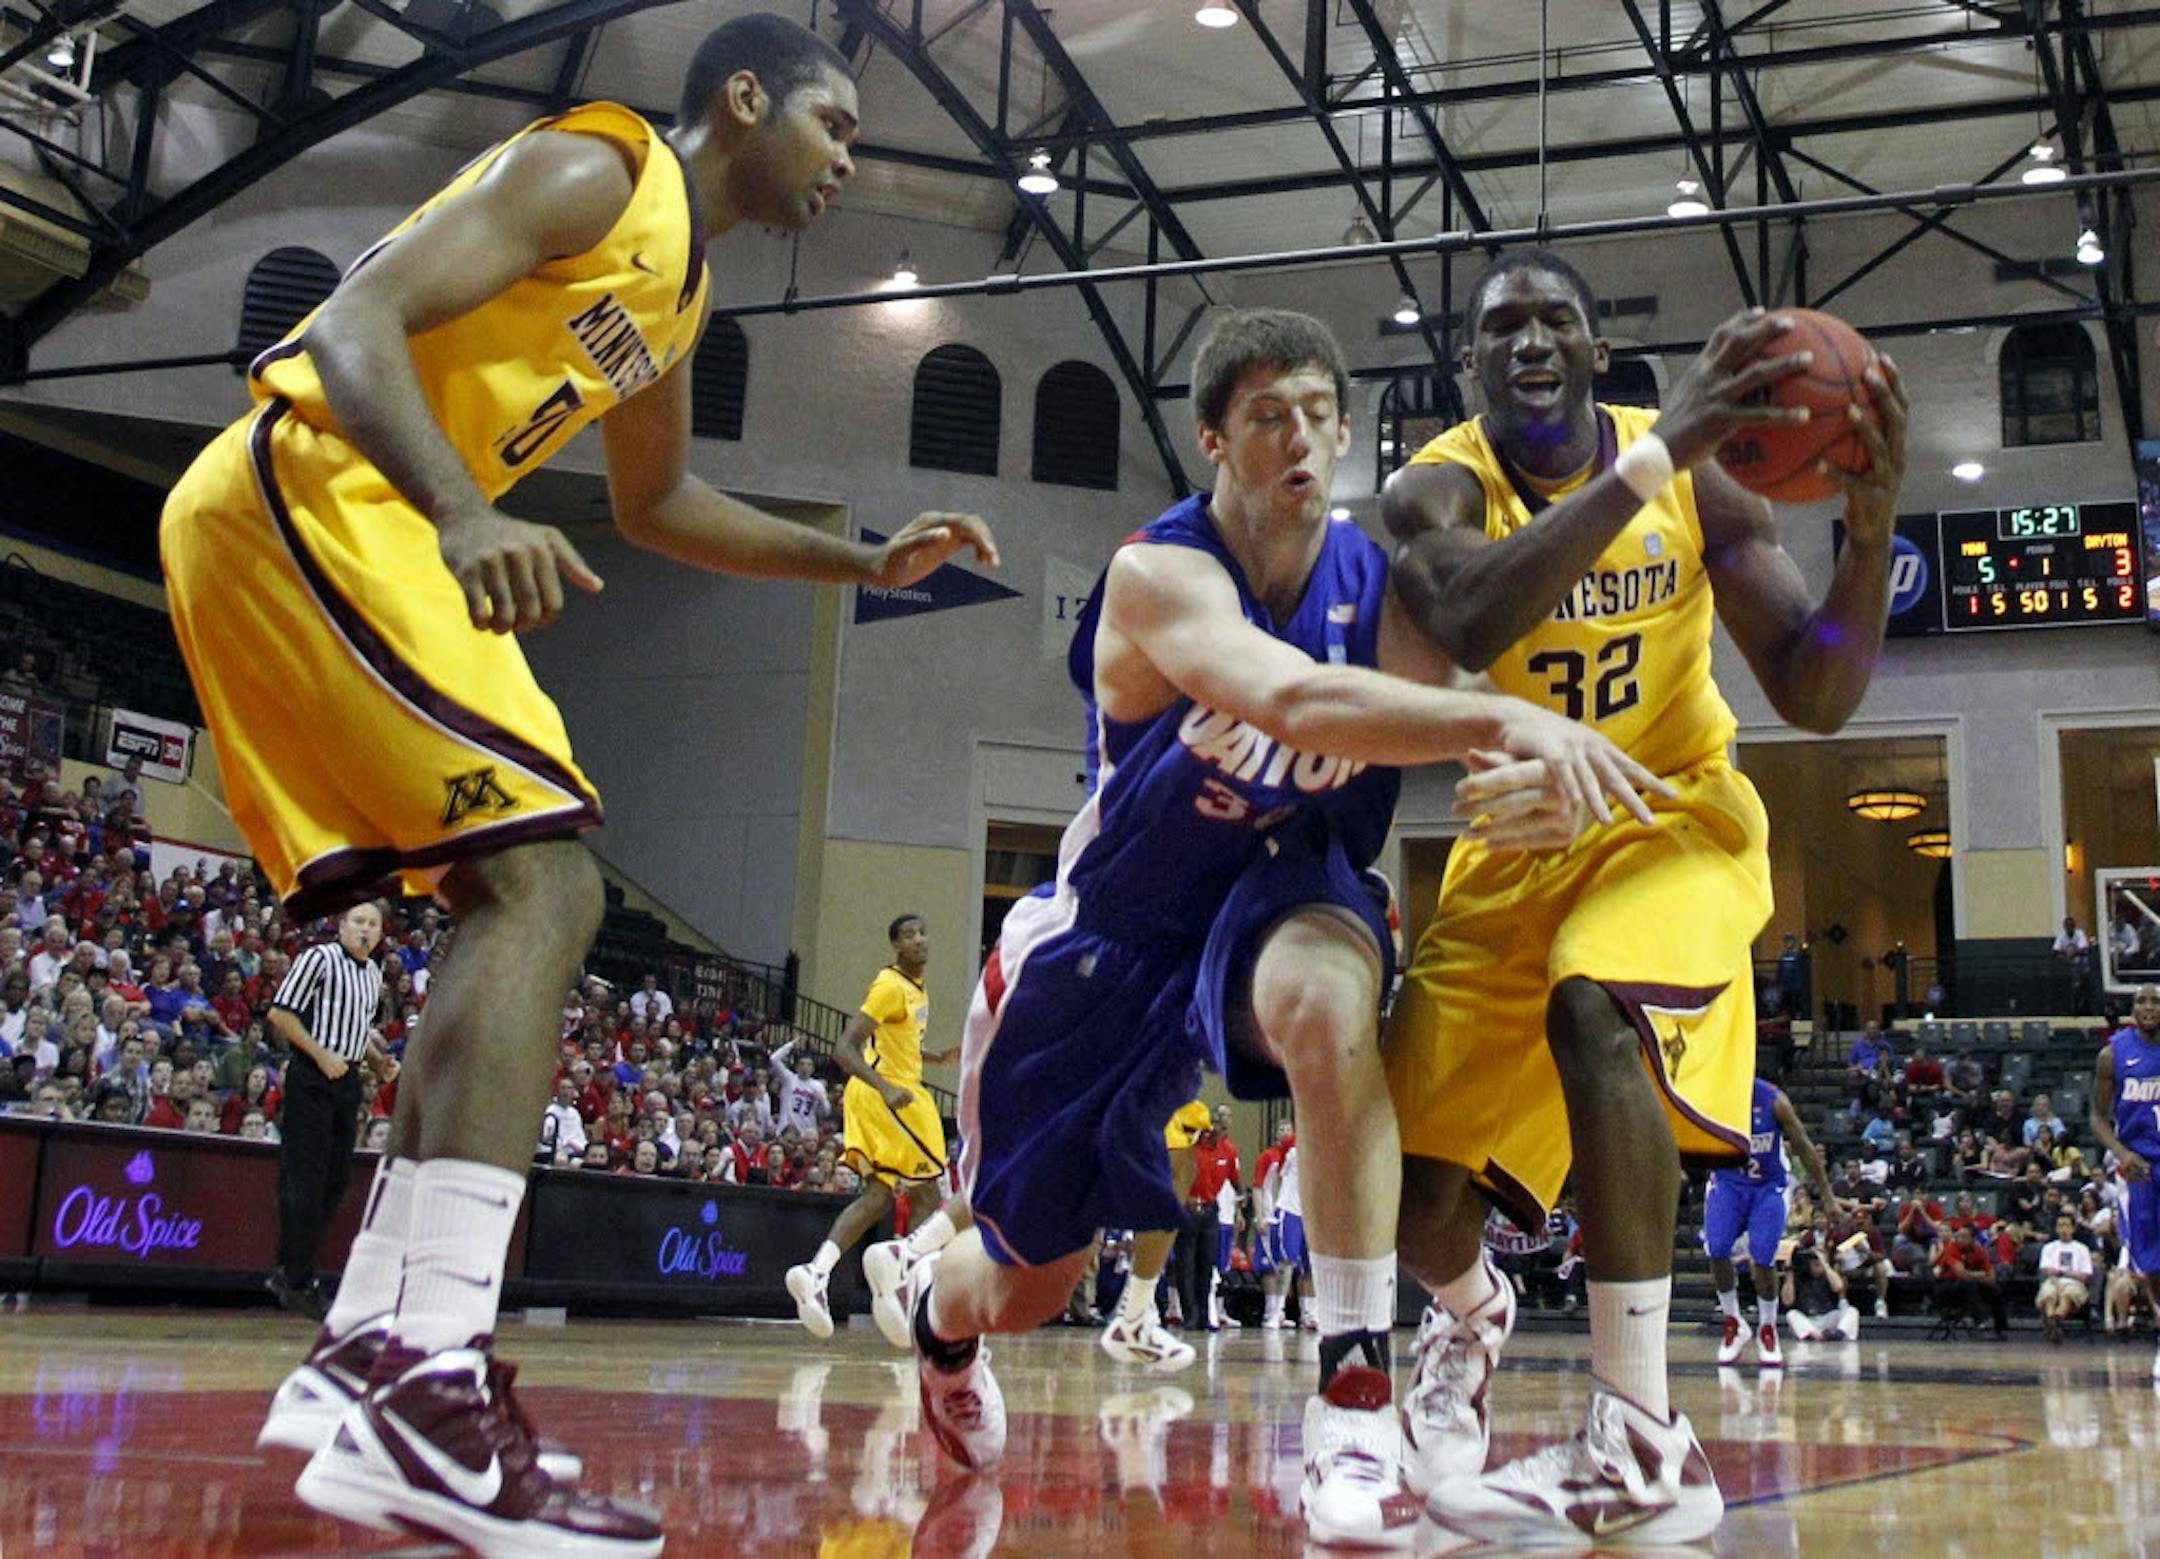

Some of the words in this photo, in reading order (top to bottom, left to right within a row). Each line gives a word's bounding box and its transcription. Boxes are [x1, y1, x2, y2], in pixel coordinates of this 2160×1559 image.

[2012, 507, 2076, 535] 15:27
[1978, 556, 1995, 583] 5
[2043, 557, 2050, 575] 1
[2115, 548, 2132, 576] 3
[1969, 595, 1978, 614] 1
[1992, 592, 2006, 615] 5
[2020, 589, 2050, 613] 50
[2061, 591, 2069, 609] 1
[2083, 587, 2098, 610] 5
[2119, 585, 2133, 607] 2
[1527, 633, 1642, 721] 32
[55, 1184, 127, 1248] Old
[120, 1192, 202, 1260] Spice
[659, 1226, 701, 1275] Old
[697, 1230, 747, 1280] Spice
